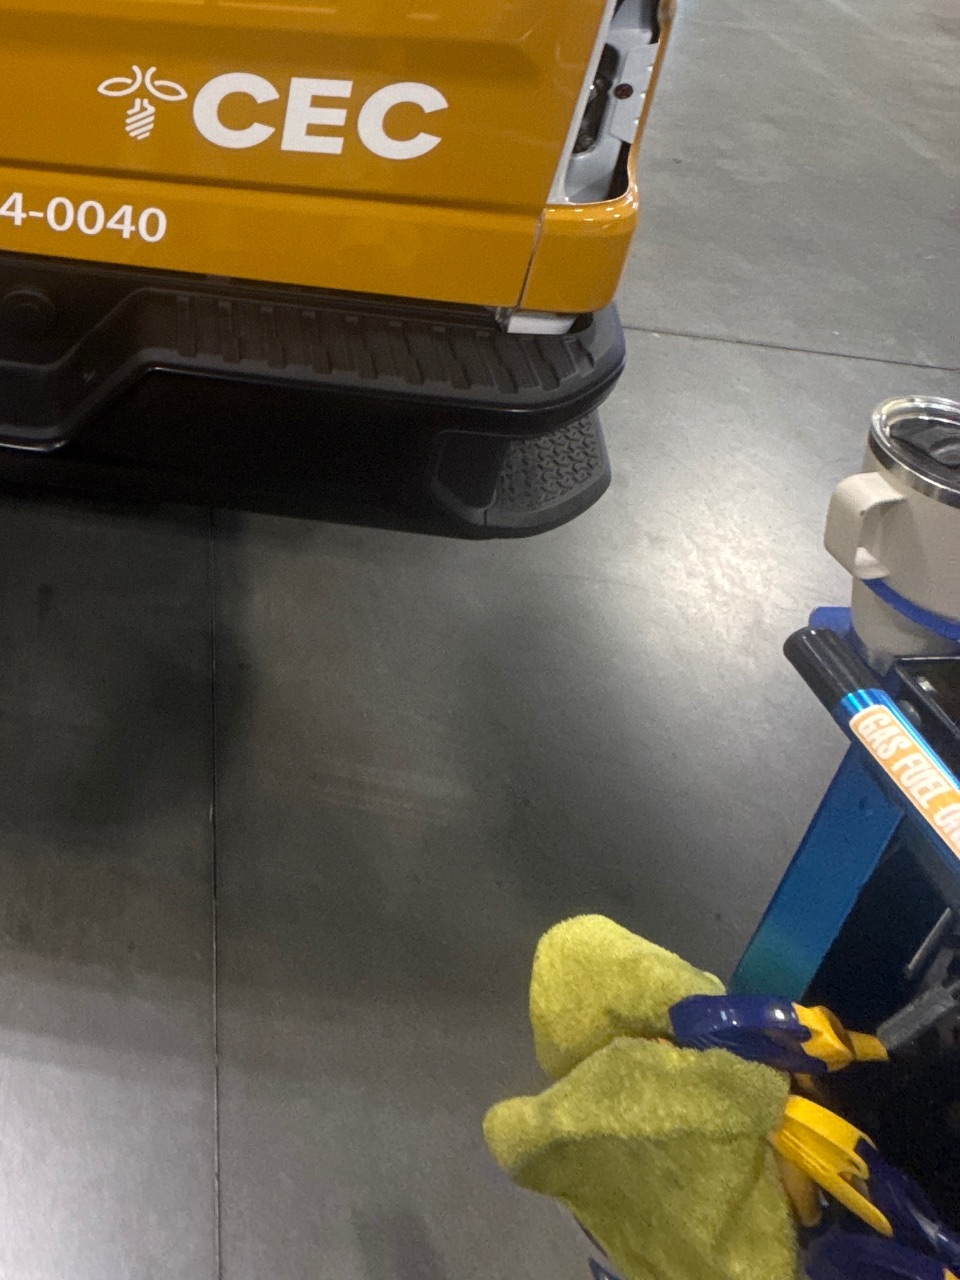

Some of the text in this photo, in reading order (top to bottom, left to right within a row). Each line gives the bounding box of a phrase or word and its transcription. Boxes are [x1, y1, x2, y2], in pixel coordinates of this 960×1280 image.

[192, 72, 449, 160] CEC
[857, 713, 914, 761] GAS
[890, 751, 952, 810] FUEL
